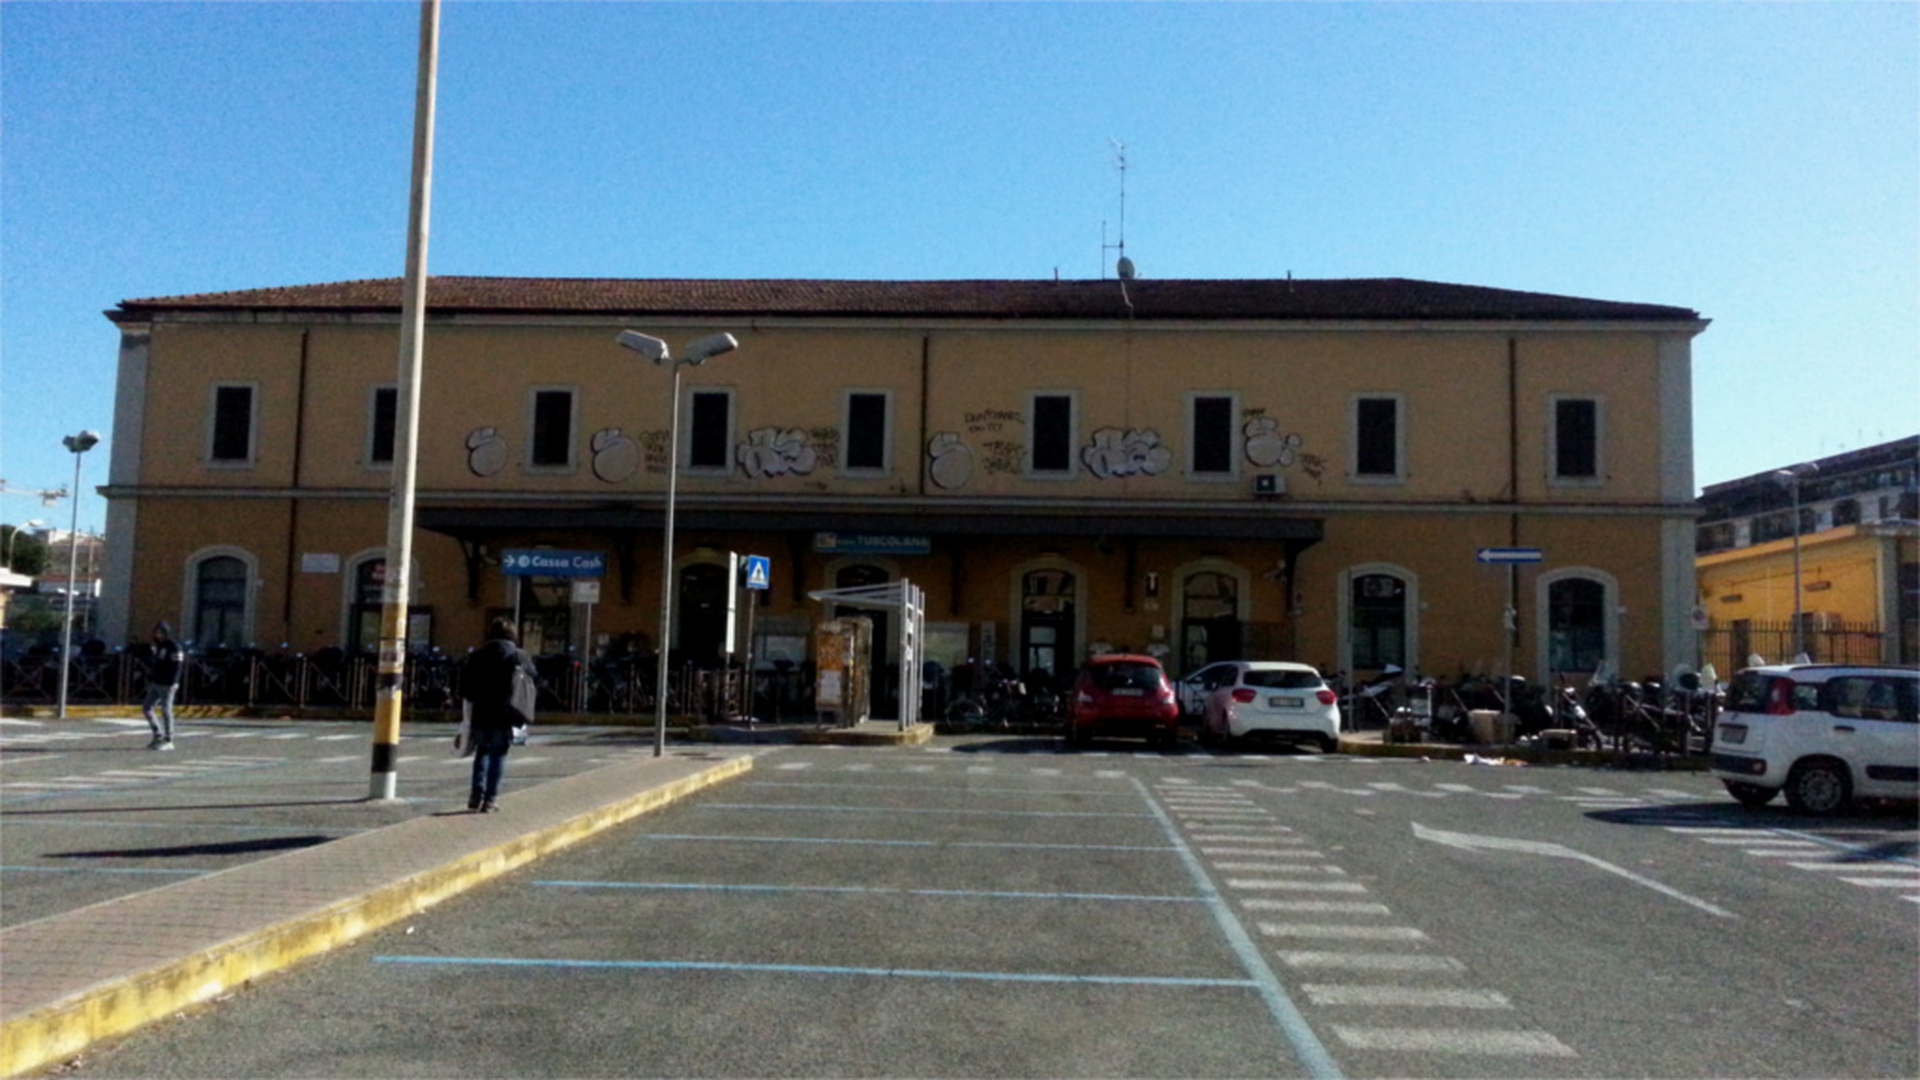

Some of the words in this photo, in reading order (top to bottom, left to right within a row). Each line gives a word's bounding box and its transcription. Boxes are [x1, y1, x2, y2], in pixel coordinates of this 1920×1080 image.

[857, 535, 930, 547] TUSCOLANA
[532, 556, 569, 568] Cassa
[572, 556, 602, 568] Cash
